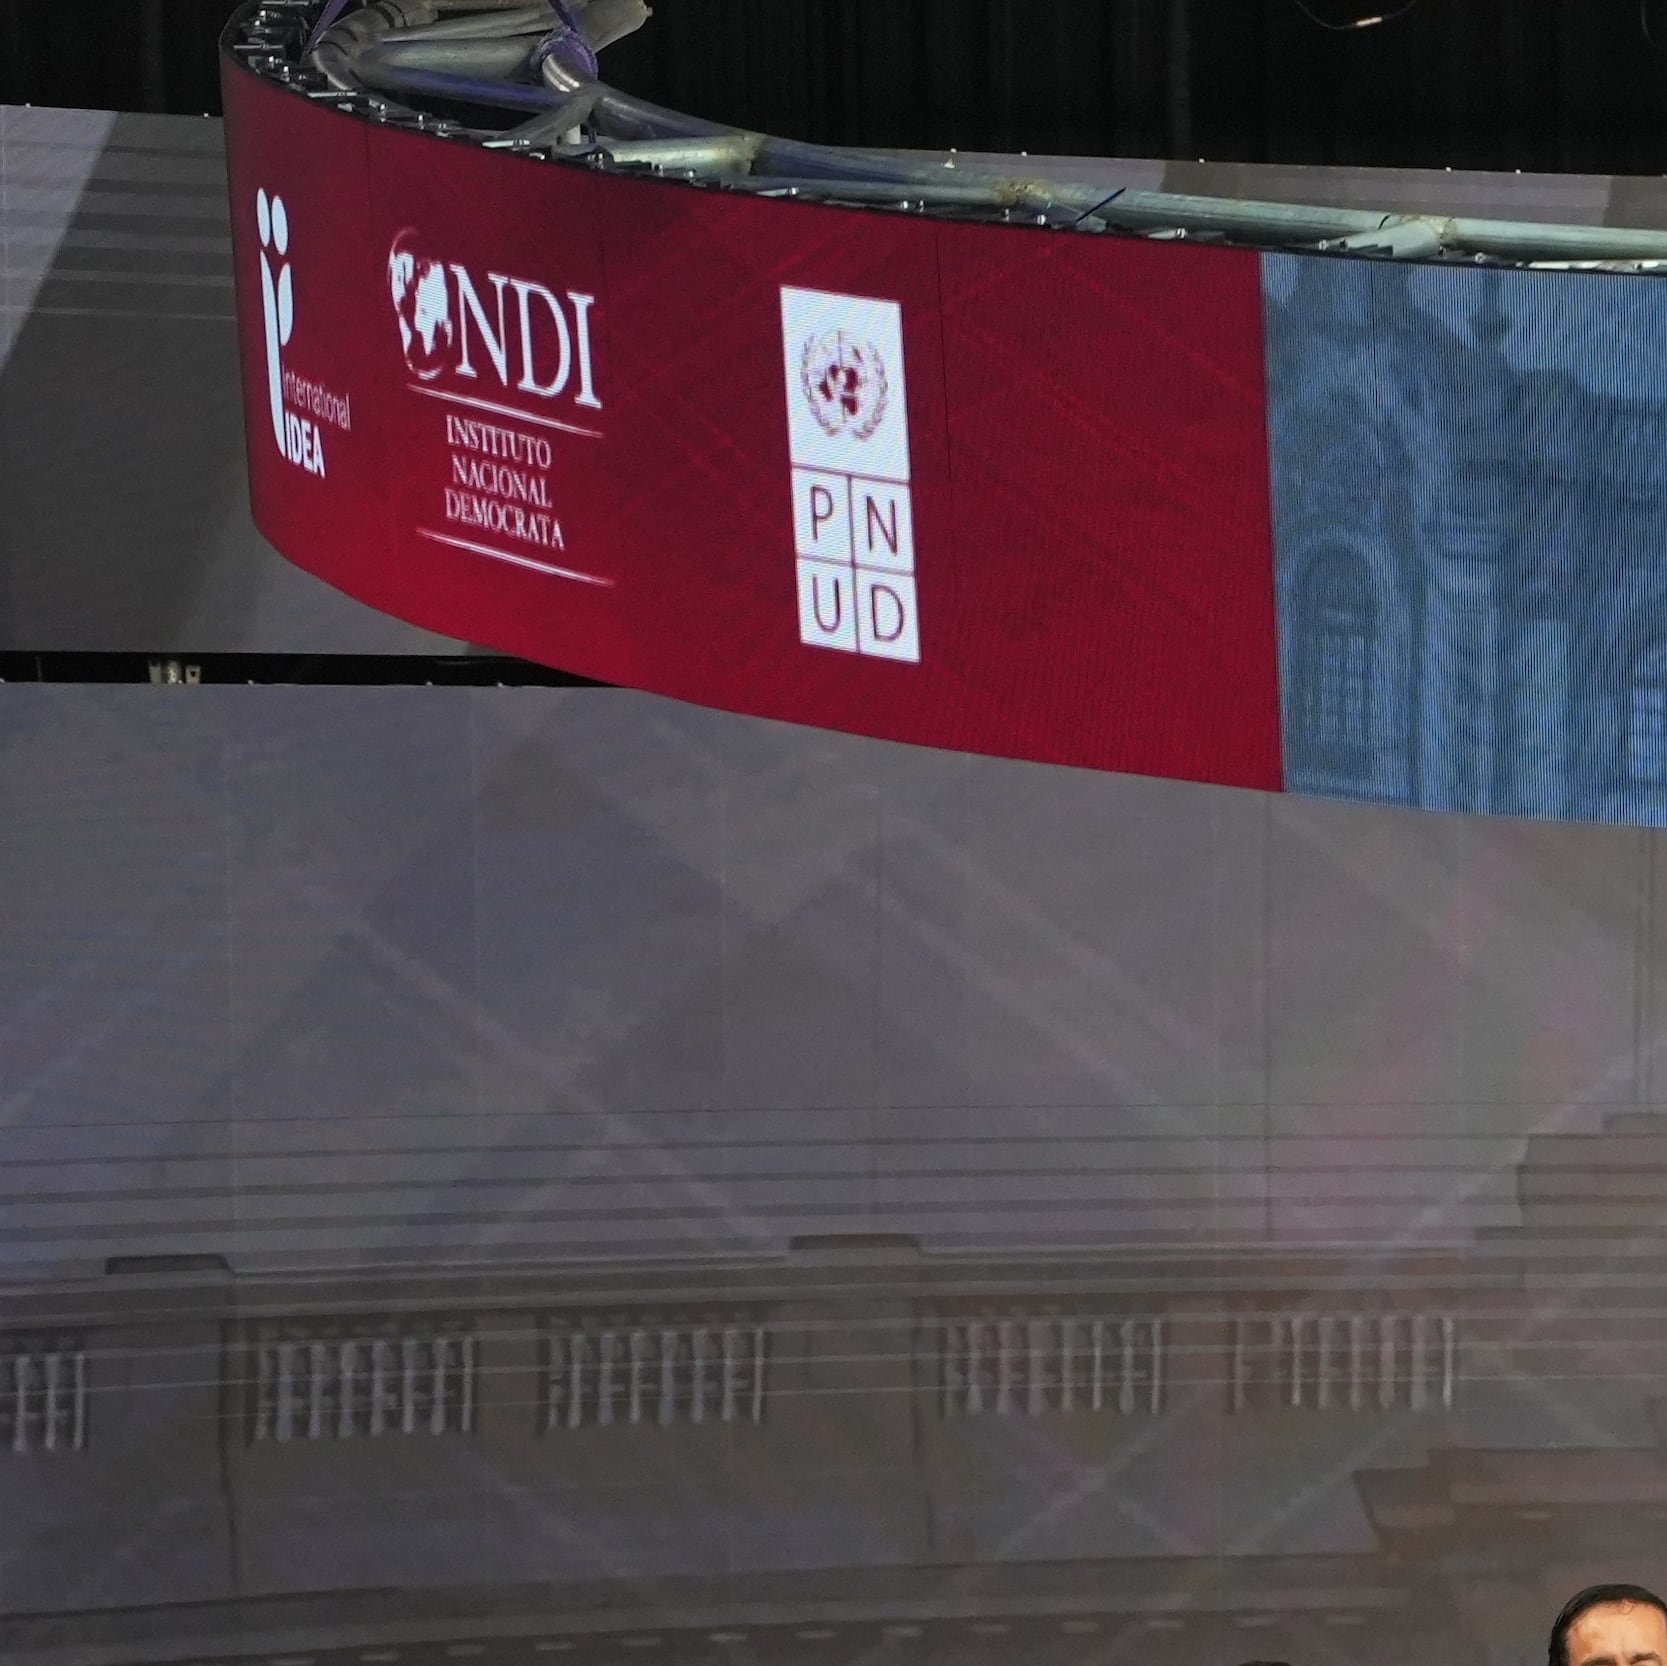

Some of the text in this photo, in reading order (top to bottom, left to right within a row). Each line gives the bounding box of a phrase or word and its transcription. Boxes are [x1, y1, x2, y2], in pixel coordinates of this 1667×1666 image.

[449, 263, 602, 409] NDI
[284, 411, 326, 478] IDEA
[446, 414, 552, 470] INSTITUTO
[452, 452, 553, 509] NACIONAL
[444, 487, 565, 551] DEMOCRATA
